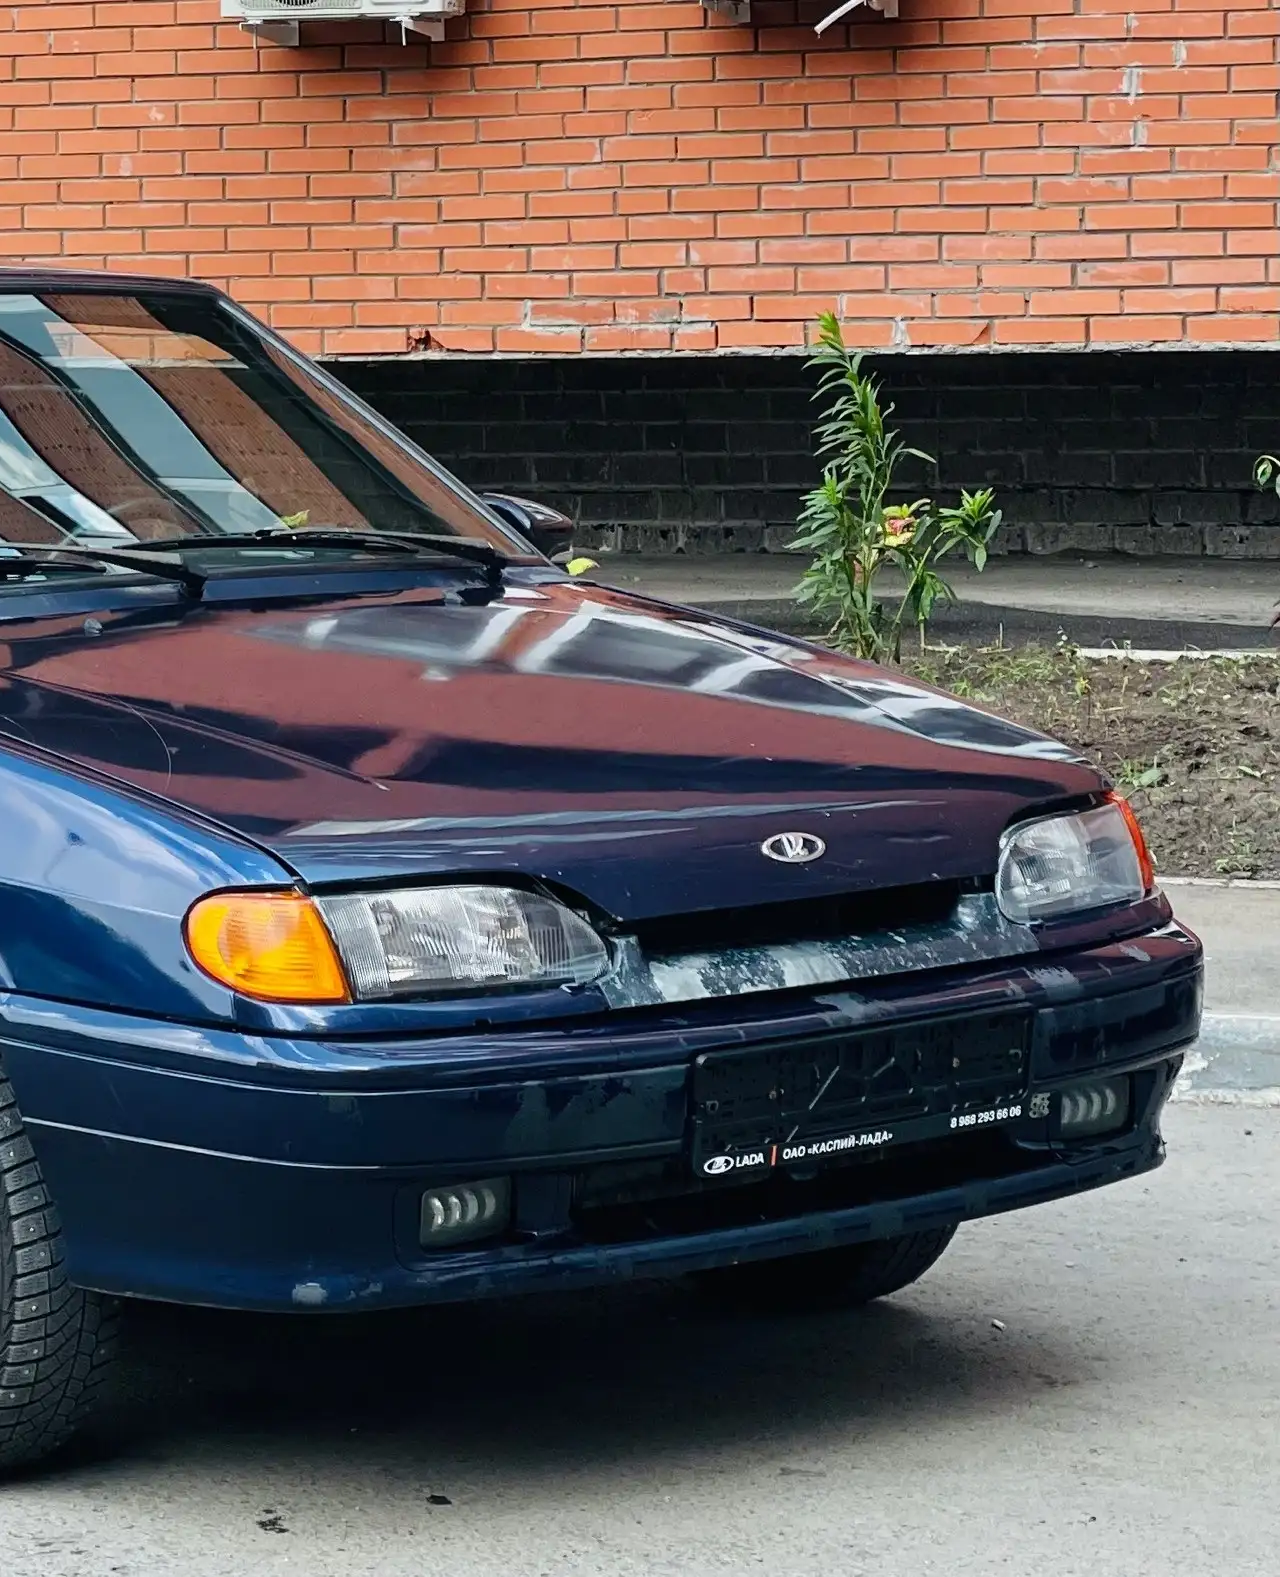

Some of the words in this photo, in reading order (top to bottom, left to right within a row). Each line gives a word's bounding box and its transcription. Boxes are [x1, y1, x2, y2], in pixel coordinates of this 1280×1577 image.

[950, 1117, 957, 1128] 8
[977, 1110, 995, 1123] 293
[996, 1108, 1008, 1119] 66
[1009, 1105, 1022, 1117] 06
[782, 1145, 806, 1160] ОАО
[807, 1130, 893, 1154] «КАСПИЙ-ЛАДА»
[735, 1152, 765, 1168] LADA
